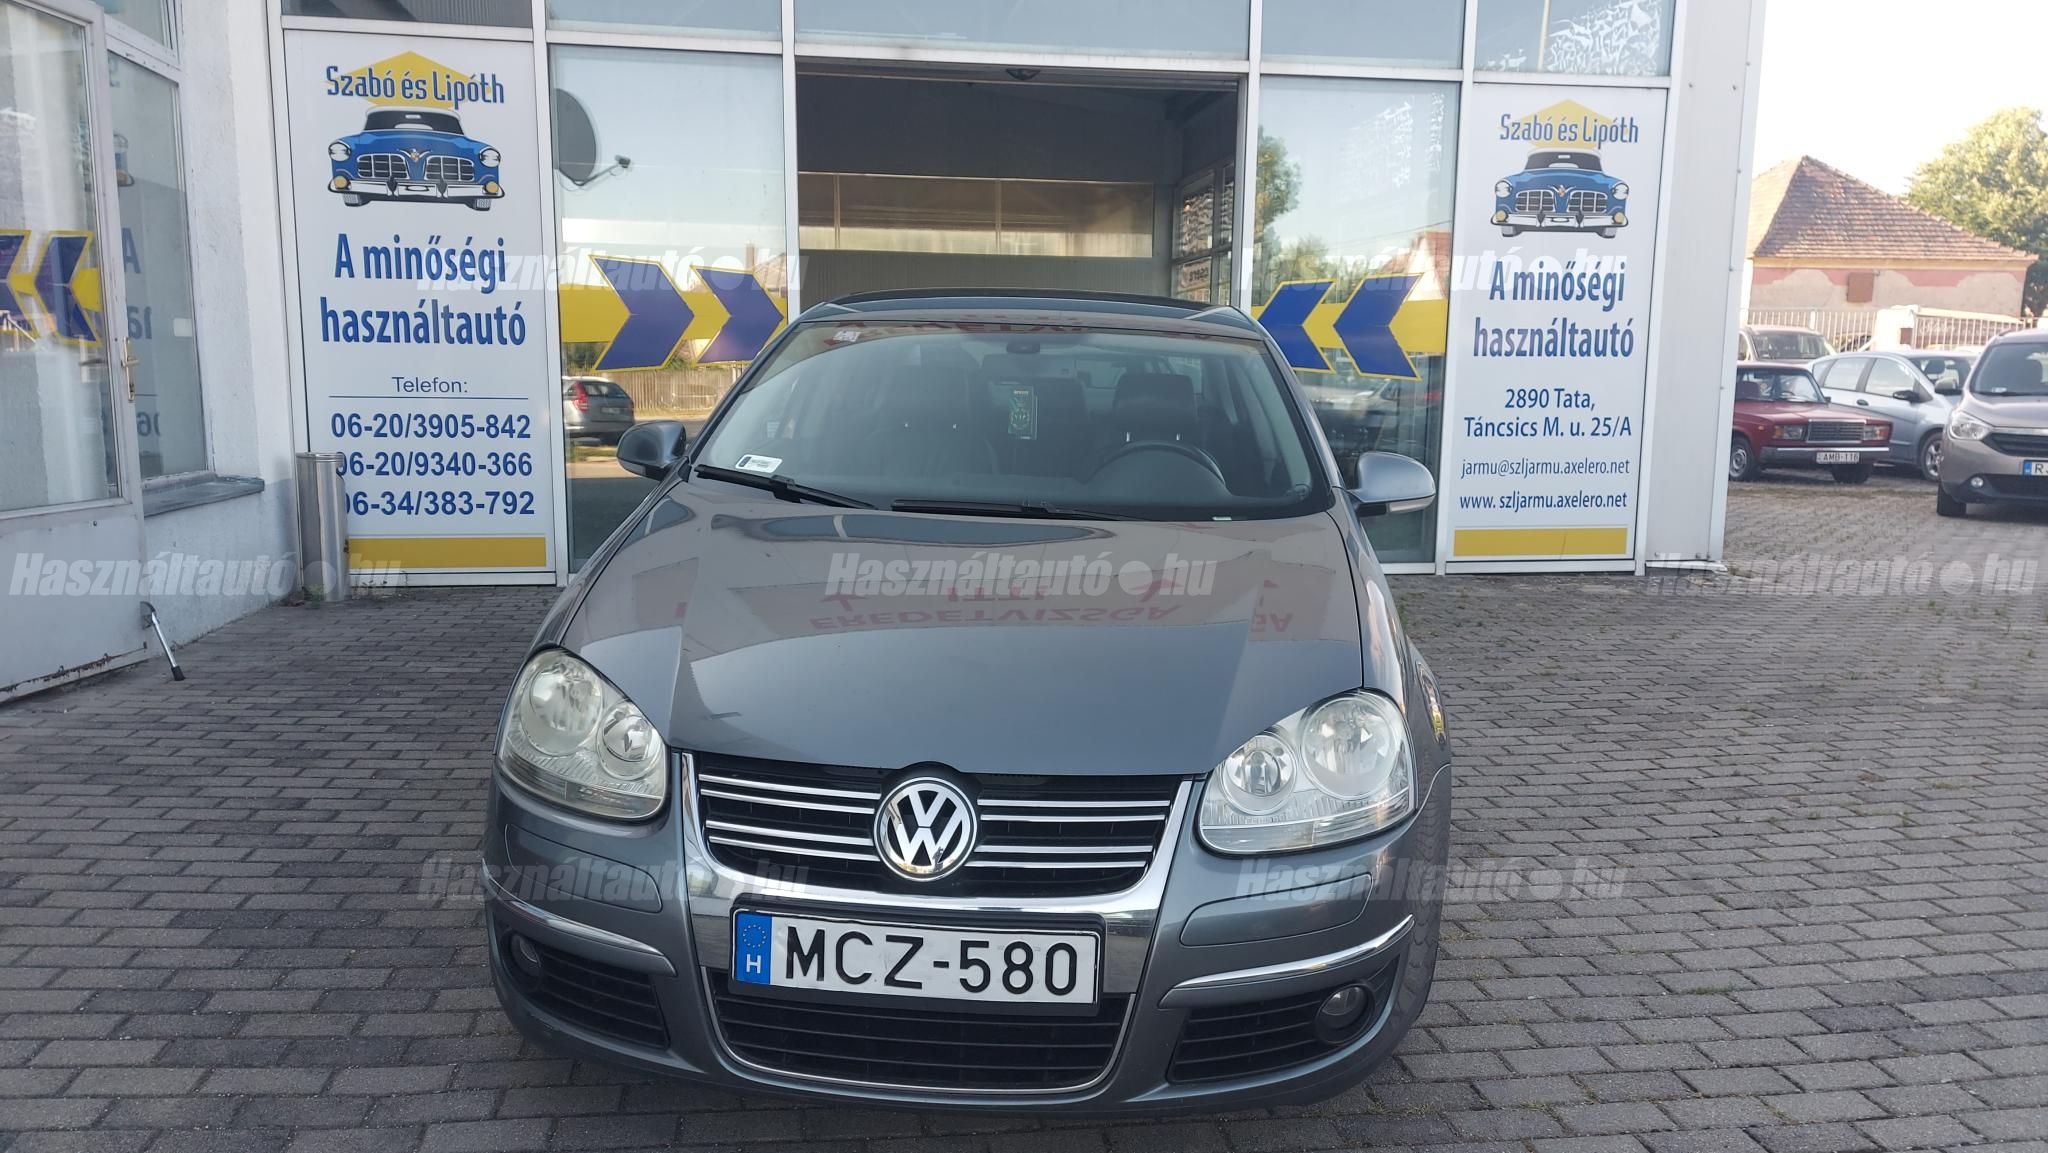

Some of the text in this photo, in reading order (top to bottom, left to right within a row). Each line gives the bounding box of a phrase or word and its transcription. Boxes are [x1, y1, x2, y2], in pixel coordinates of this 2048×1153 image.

[325, 65, 504, 111] Szabó és Lipóth
[1499, 113, 1639, 150] Szabó és Lipóth
[334, 233, 507, 294] A minőségi
[1489, 260, 1626, 313] A minőségi
[319, 296, 526, 346] használtautó
[1472, 316, 1635, 358] használtautó
[391, 376, 469, 393] Telefon:
[1504, 387, 1596, 411] 2890 Tata,
[331, 412, 532, 439] 06-20/3905-842
[1464, 416, 1632, 438] Táncsics M. u. 25/A
[1460, 457, 1631, 480] jarmu@szljarmu.axelero.net
[746, 925, 1078, 997] H MCZ-580
